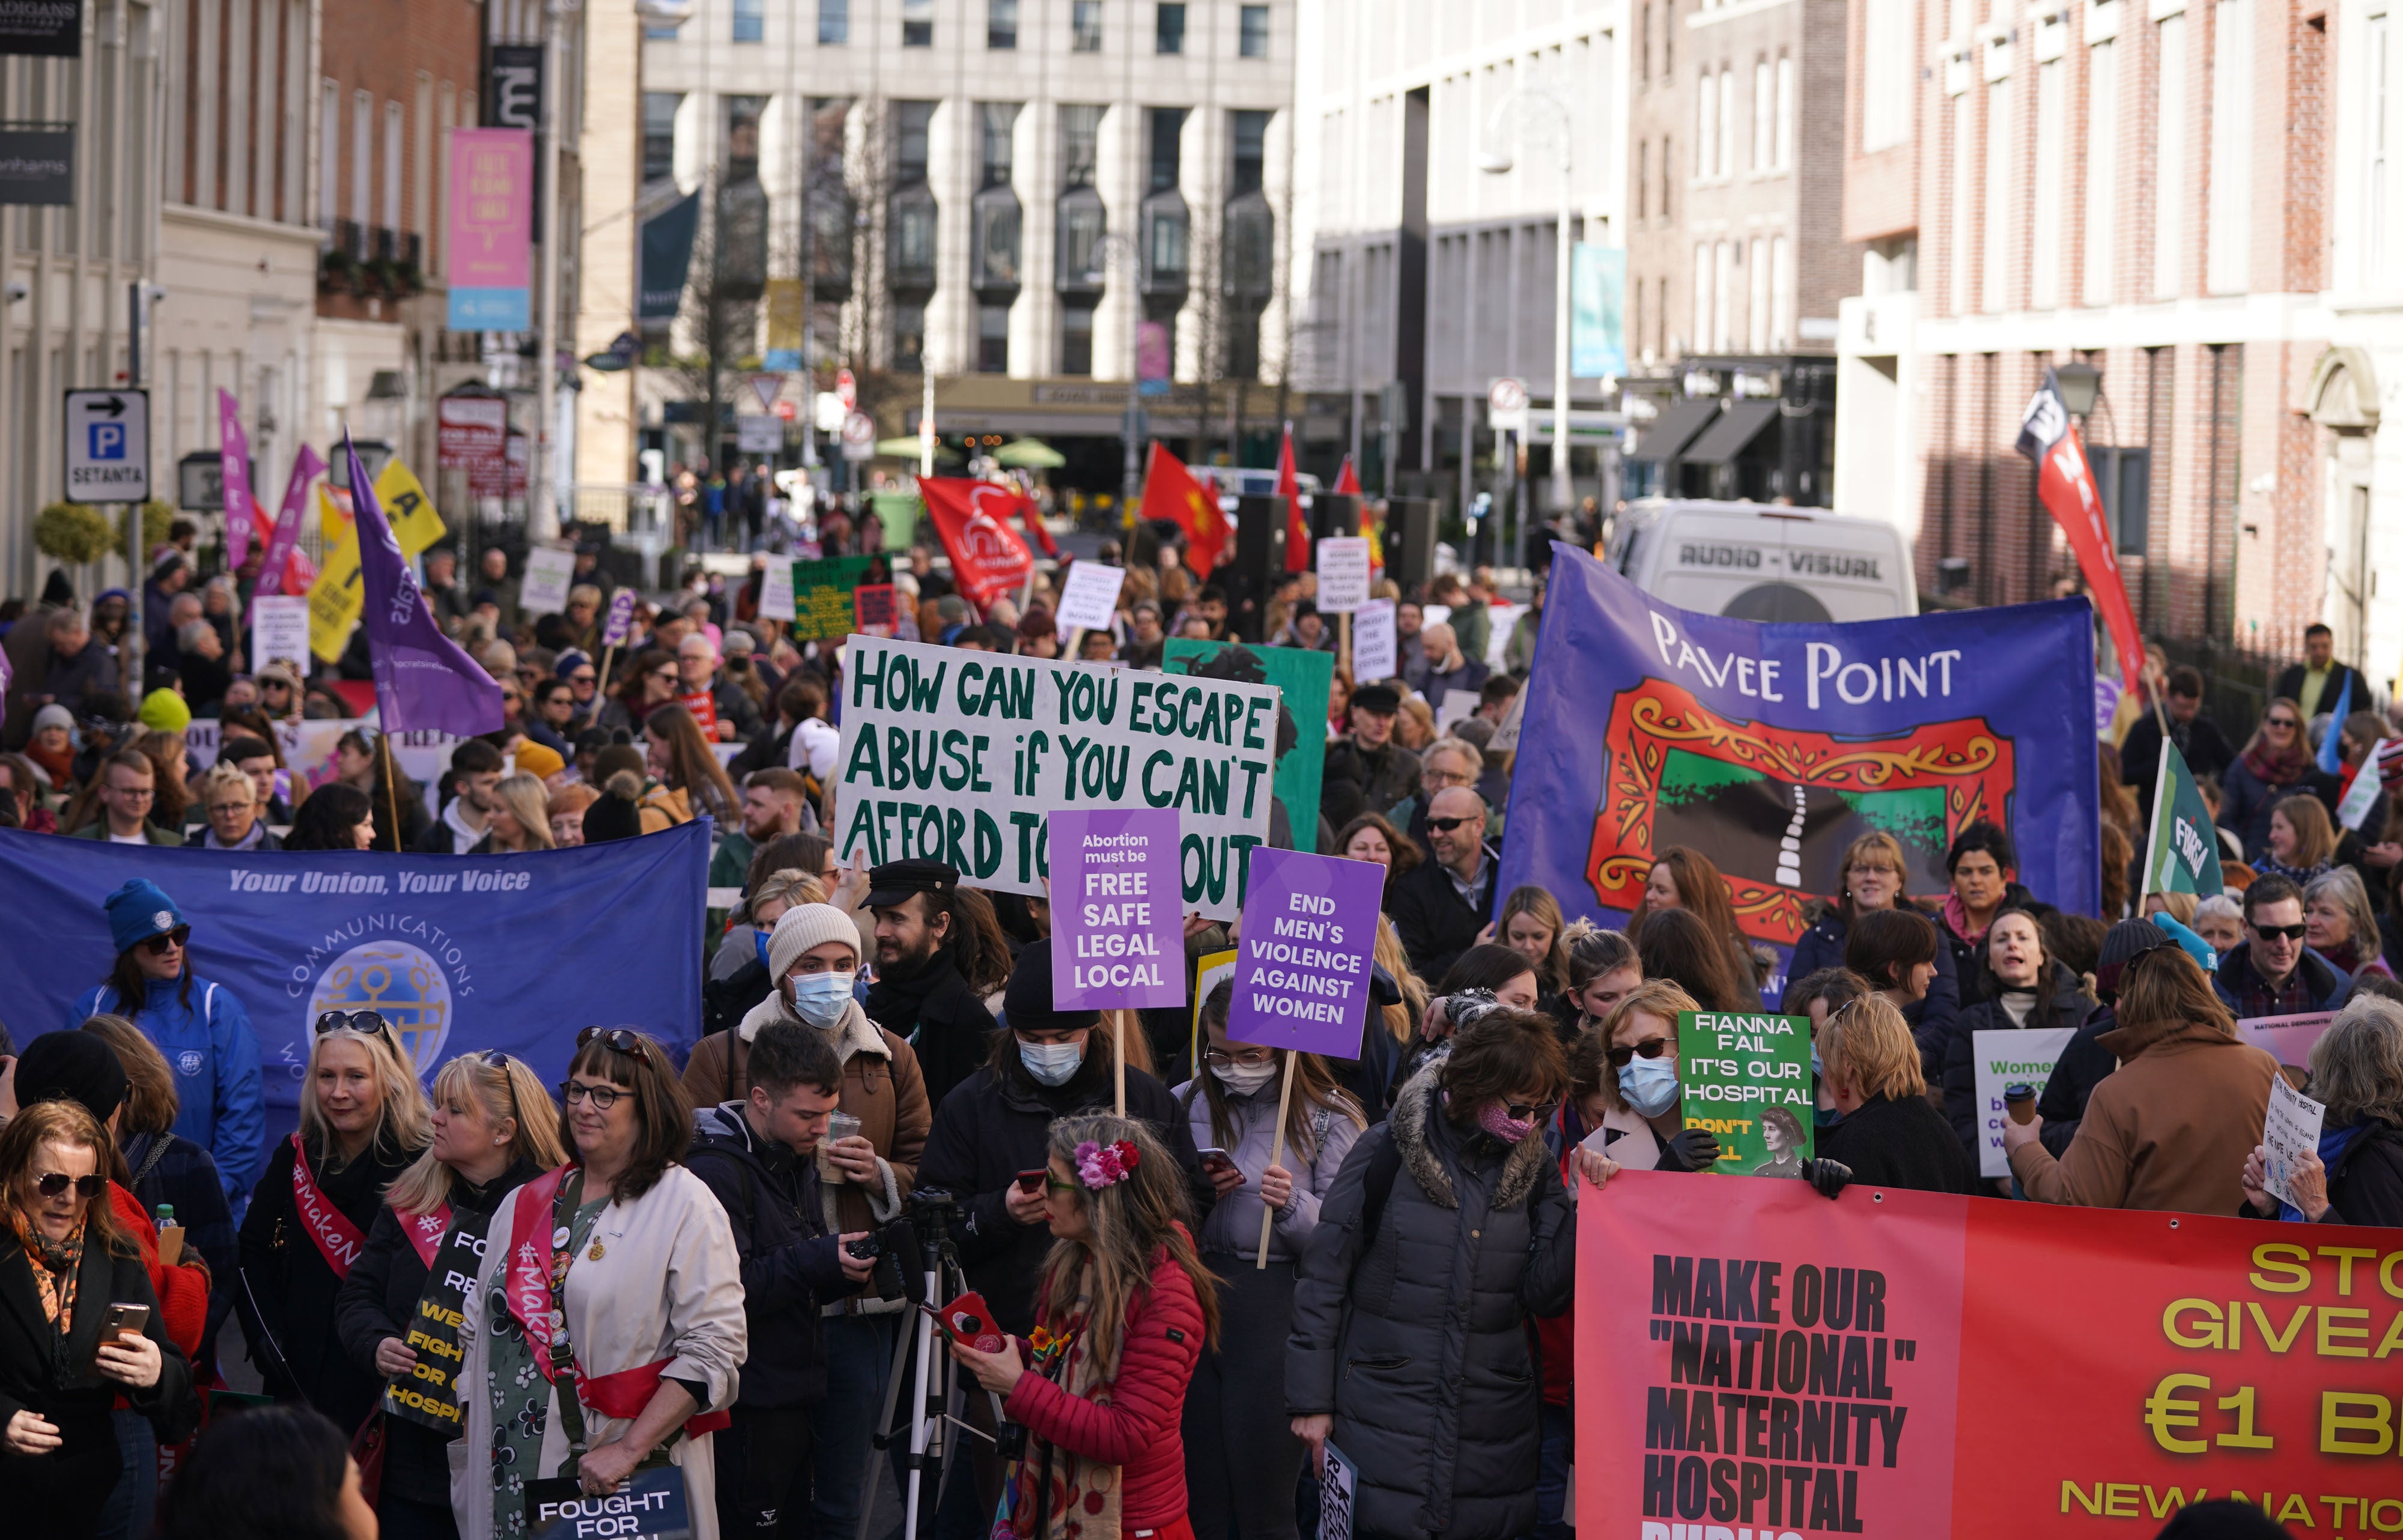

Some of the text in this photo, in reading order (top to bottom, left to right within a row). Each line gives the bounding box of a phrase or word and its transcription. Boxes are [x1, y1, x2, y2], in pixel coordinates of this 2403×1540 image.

[73, 467, 143, 483] SETANTA
[1680, 544, 1761, 568] AUDIO
[1788, 551, 1882, 580] VISUAL
[1649, 610, 1961, 709] PAVEE POINT
[853, 649, 1272, 750] HOW CAN YOU ESCAPE
[845, 723, 1268, 819] ABUSE if YOU CAN'T
[841, 799, 1001, 879] AFFORD
[1082, 833, 1149, 847] Abortion
[1085, 849, 1147, 864] must be
[229, 869, 531, 896] Your Union, Your Voice
[1086, 872, 1148, 896] FREE
[1084, 902, 1151, 927] SAFE
[1289, 892, 1336, 916] END
[1273, 917, 1344, 944] MEN'S
[287, 913, 474, 998] COMMUNICATIONS
[1077, 933, 1160, 957] LEGAL
[1250, 939, 1362, 974] VIOLENCE
[1075, 963, 1164, 989] LOCAL
[1249, 968, 1354, 999] AGAINST
[1253, 993, 1345, 1025] WOMEN
[1695, 1014, 1794, 1035] FIANNA
[1718, 1034, 1774, 1053] FAIL
[1691, 1058, 1801, 1079] IT'S OUR
[1990, 1060, 2057, 1074] Wome
[1685, 1084, 1813, 1105] HOSPITAL
[2298, 1099, 2316, 1115] HOSPITAL
[2299, 1128, 2314, 1141] IRELAND
[516, 1241, 550, 1344] #Make
[1651, 1254, 1886, 1333] MAKE OUR
[407, 1330, 463, 1363] FIGH
[1650, 1319, 1916, 1400] "NATIONAL"
[412, 1362, 446, 1386] OR
[387, 1384, 461, 1423] HOSPI
[2144, 1372, 2274, 1453] €1
[1645, 1386, 1908, 1469] MATERNITY
[539, 1491, 670, 1521] FOUGHT
[1642, 1454, 1864, 1533] HOSPITAL
[2061, 1480, 2207, 1519] NEW
[576, 1515, 639, 1539] FOR
